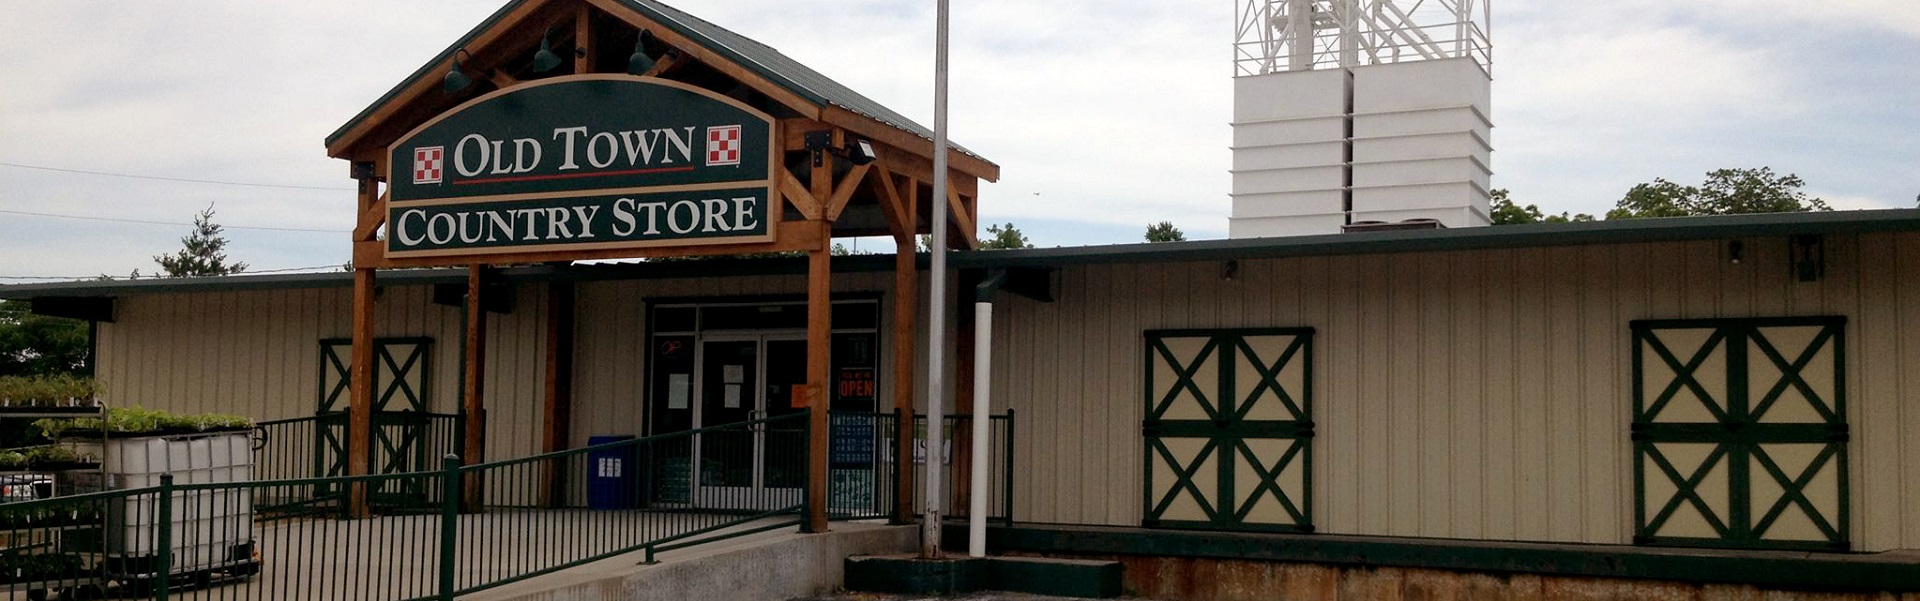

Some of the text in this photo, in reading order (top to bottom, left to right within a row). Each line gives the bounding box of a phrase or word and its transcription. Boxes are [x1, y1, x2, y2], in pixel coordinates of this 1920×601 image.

[454, 125, 696, 177] OLD TOWN
[397, 196, 758, 247] COUNTRY STORE
[841, 380, 873, 397] OPEN
